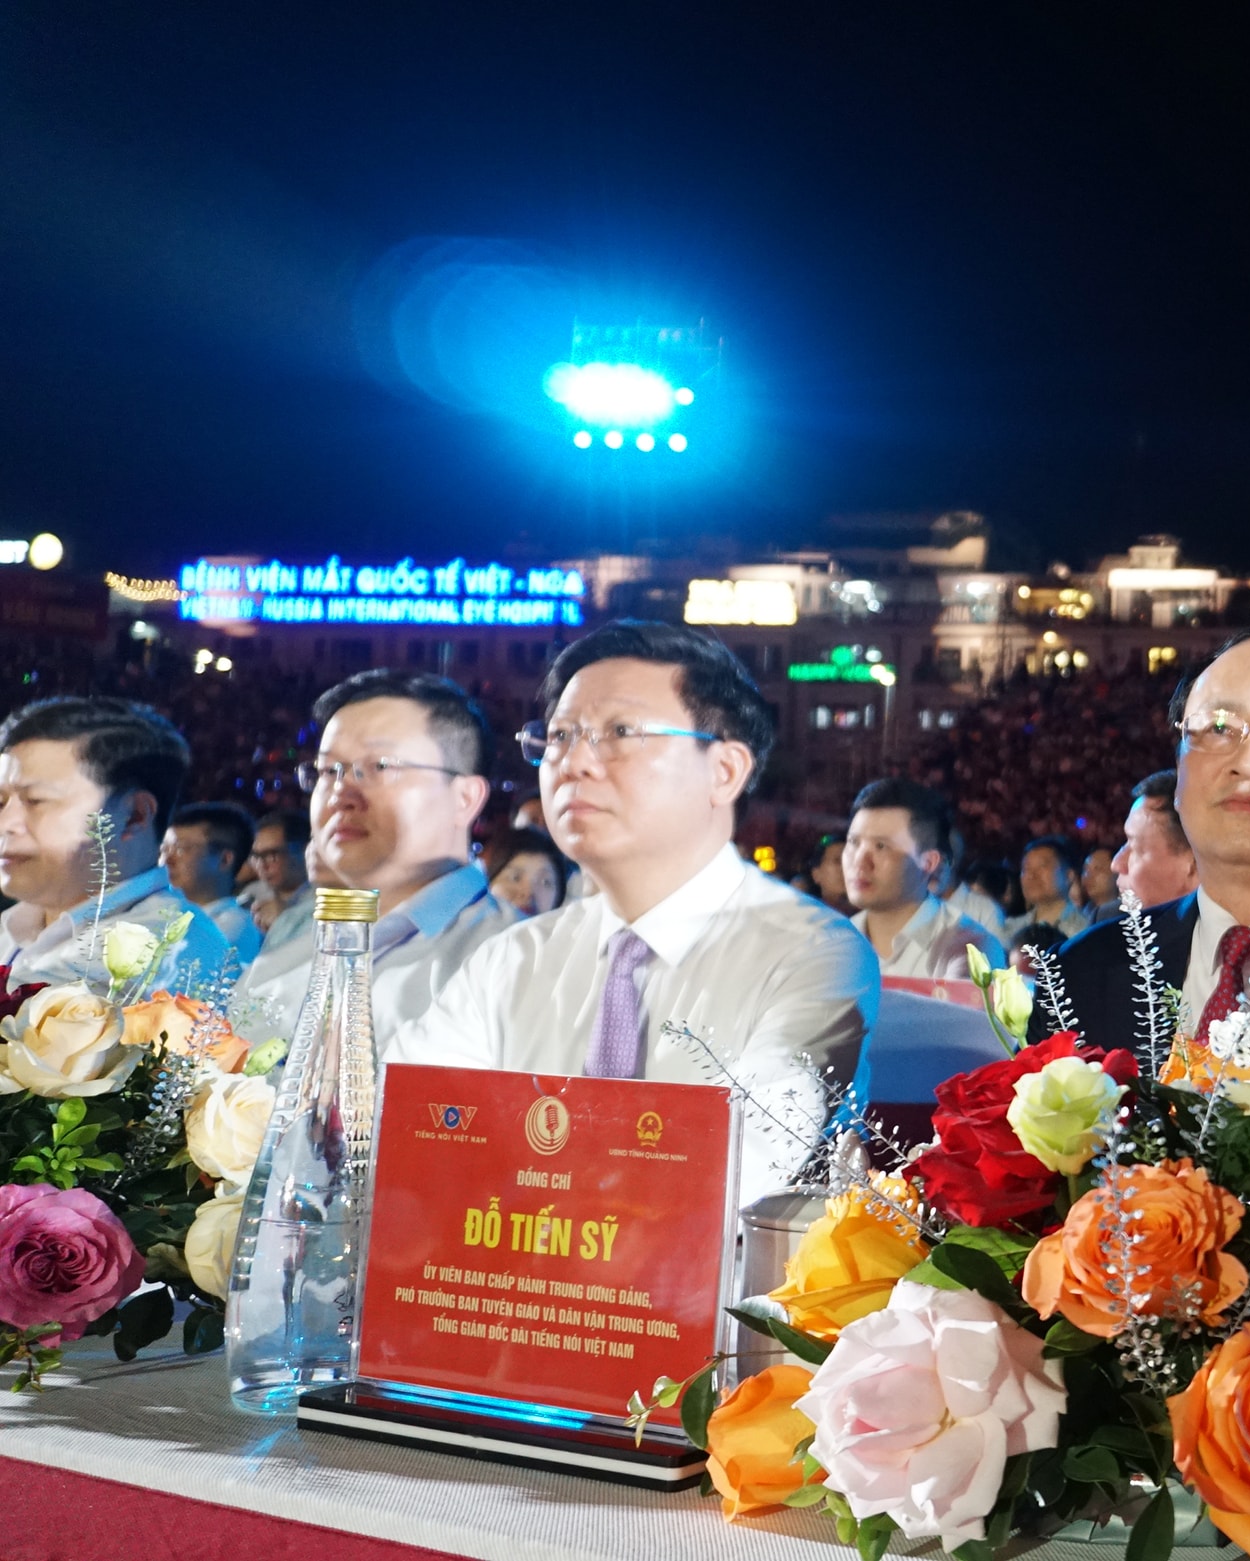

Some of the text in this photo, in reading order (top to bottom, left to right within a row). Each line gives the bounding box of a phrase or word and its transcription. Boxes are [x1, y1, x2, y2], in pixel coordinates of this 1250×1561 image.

[356, 556, 429, 595] QUỐC
[433, 557, 464, 595] TẾ
[463, 562, 513, 597] VIỆT
[528, 568, 584, 596] NGA
[327, 597, 460, 624] INTERNATIONAL
[415, 1130, 436, 1140] TIẾNG
[453, 1133, 469, 1143] VIỆT
[471, 1136, 487, 1144] NAM
[608, 1148, 628, 1157] UBND
[670, 1154, 688, 1162] NINH
[517, 1166, 571, 1190] ĐỒNG CHÍ
[464, 1197, 619, 1261] ĐỖ TIẾN SỸ
[423, 1260, 653, 1310] ỦY VIÊN BAN CHẤP HÀNH TRUNG ƯƠNG ĐẢNG,
[395, 1286, 681, 1341] PHÓ TRƯỞNG BAN TUYÊN GIÁO VÀ DÂN VẬN TRUNG ƯƠNG,
[433, 1312, 634, 1360] TỔNG GIÁM ĐỐC ĐÀI TIẾNG NÓI VIỆT NAM
